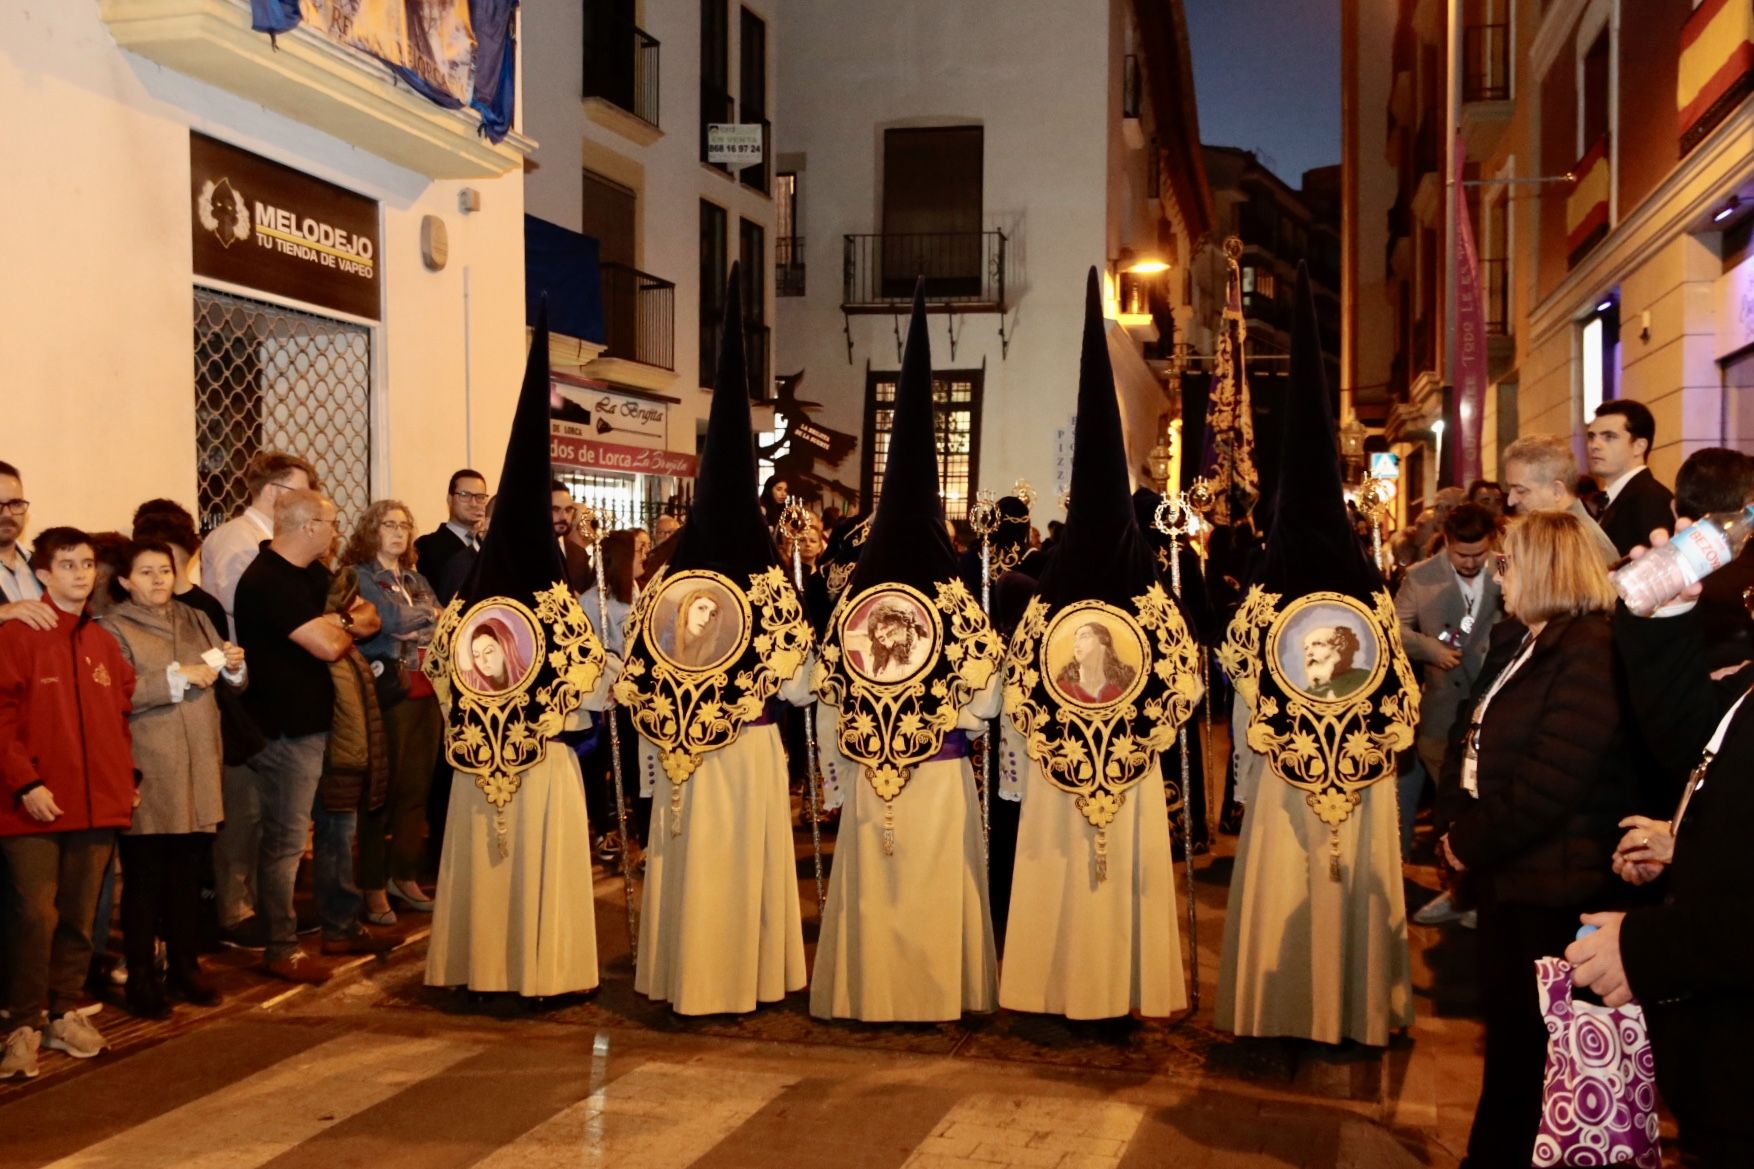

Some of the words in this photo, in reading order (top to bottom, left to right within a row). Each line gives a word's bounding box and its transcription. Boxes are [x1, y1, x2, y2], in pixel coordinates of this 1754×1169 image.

[726, 144, 737, 152] 16
[738, 144, 748, 152] 97
[750, 144, 761, 153] 24
[255, 201, 373, 259] MELODEJO
[256, 232, 273, 248] TU
[275, 238, 319, 263] TIENDA
[321, 253, 336, 268] DE
[338, 258, 373, 279] VAPEO
[1462, 322, 1475, 367] TODO
[595, 396, 617, 415] La
[620, 400, 663, 425] Brujita
[552, 423, 561, 434] DE
[564, 425, 583, 437] LORCA
[578, 444, 595, 463] de
[599, 448, 632, 467] Lorca
